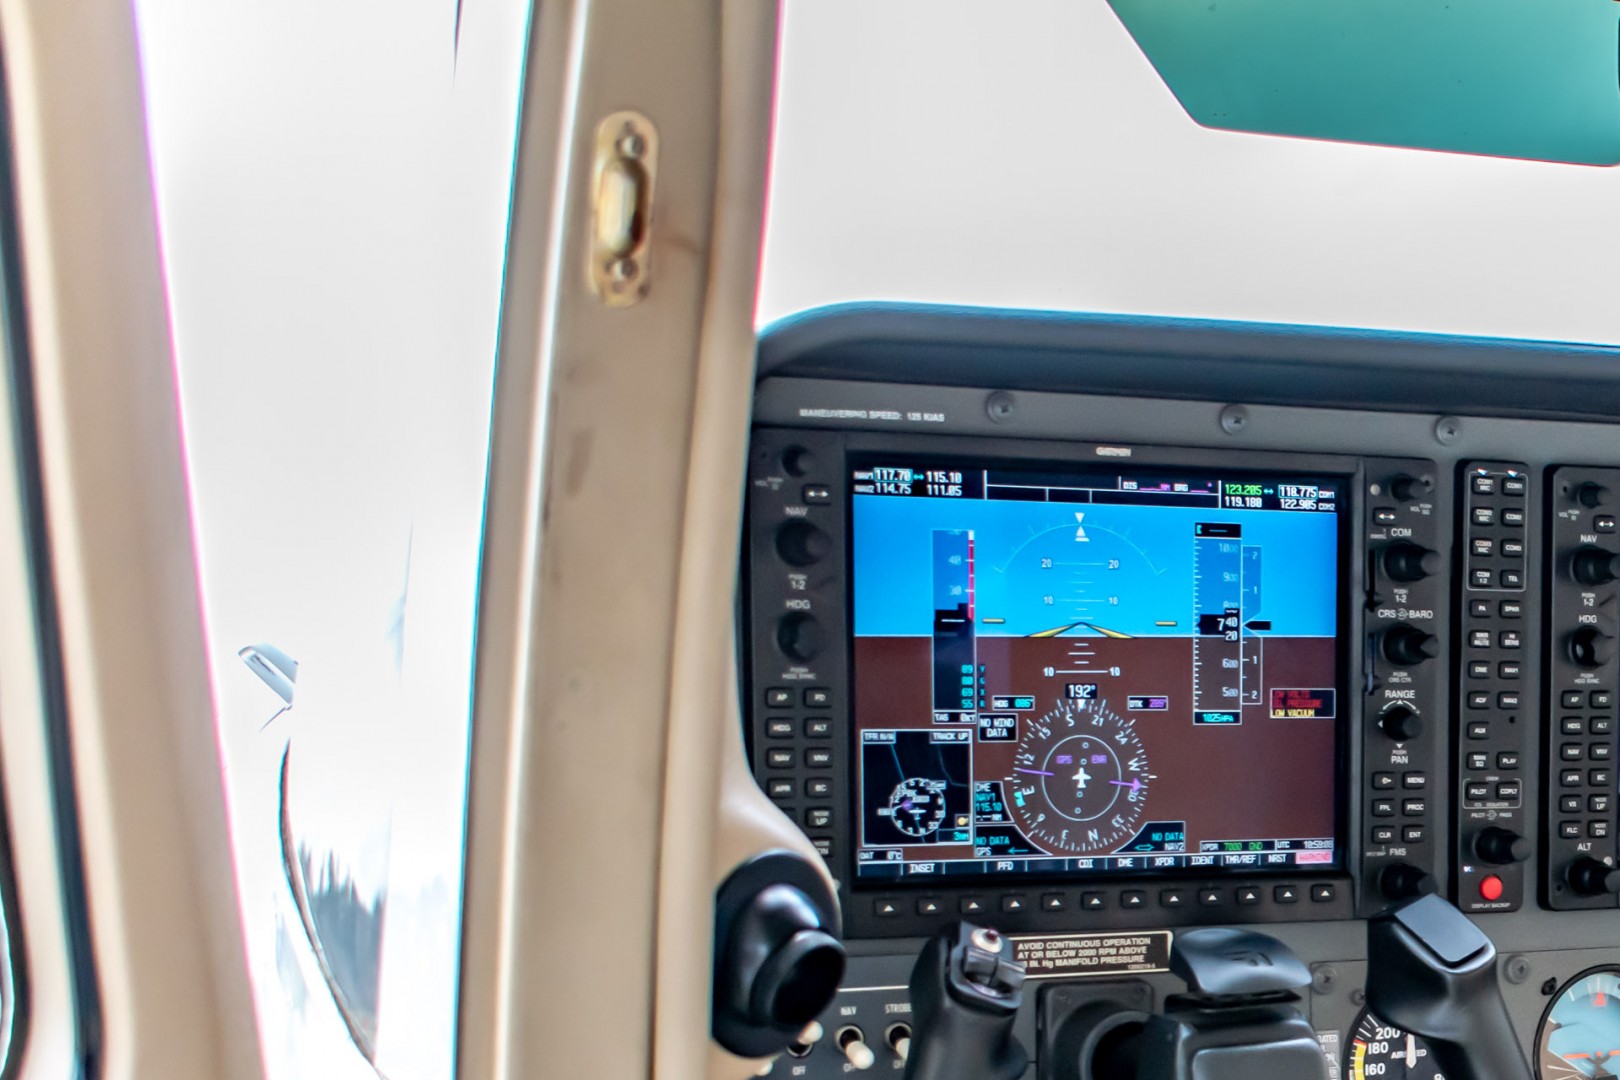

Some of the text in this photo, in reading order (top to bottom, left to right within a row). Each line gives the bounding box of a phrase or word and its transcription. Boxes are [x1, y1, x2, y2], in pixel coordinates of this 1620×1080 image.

[800, 409, 867, 420] MANEUVERING
[875, 483, 911, 495] 114.75
[1391, 528, 1412, 538] COM
[1580, 535, 1597, 543] NAV
[786, 600, 811, 610] HDG
[1378, 609, 1433, 619] CRS BARO
[1578, 615, 1597, 624] HDG
[1385, 689, 1415, 699] RANGE
[986, 728, 1008, 738] DATA
[1391, 755, 1408, 765] PAN
[1163, 831, 1184, 841] DATA
[1577, 842, 1592, 851] ALT
[910, 863, 935, 873] INSET
[1117, 857, 1133, 867] DME
[1155, 857, 1174, 867] XPDR
[1191, 855, 1214, 865] IDENT
[1225, 854, 1256, 865] TMR/REF
[1268, 853, 1287, 863] NRST
[1018, 937, 1151, 951] AVOID CONTINUOUS OPERATION
[1018, 952, 1029, 960] AT
[1031, 951, 1044, 959] OR
[1046, 949, 1076, 959] BELOW
[1098, 947, 1117, 956] RPM
[1118, 945, 1147, 955] ABOVE
[1042, 959, 1053, 970] Hg
[1055, 957, 1099, 967] MANIFOLD
[1100, 955, 1144, 965] PRESSURE
[840, 1006, 857, 1016] NAV
[1375, 1027, 1400, 1040] 200
[1368, 1042, 1389, 1055] 180
[1365, 1063, 1386, 1076] 160
